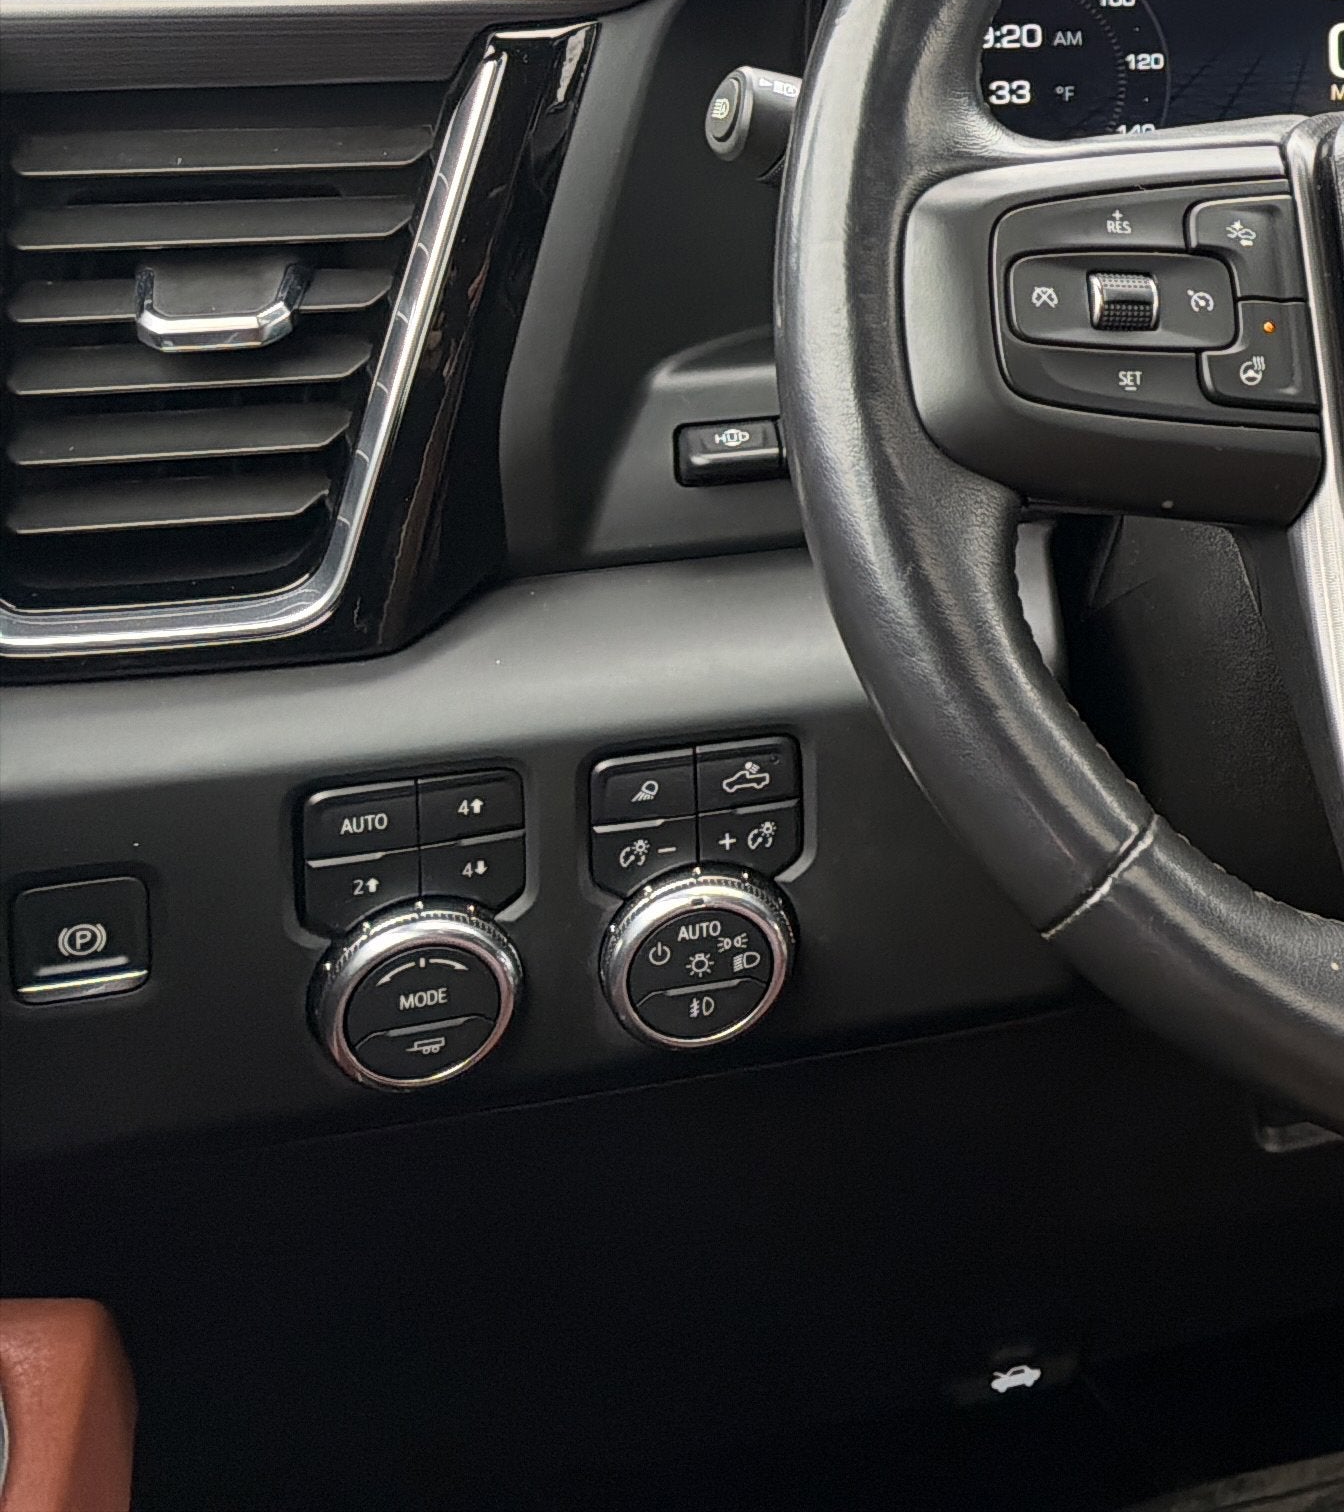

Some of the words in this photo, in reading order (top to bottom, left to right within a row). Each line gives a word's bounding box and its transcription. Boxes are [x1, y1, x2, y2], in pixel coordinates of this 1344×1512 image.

[1053, 31, 1083, 46] AM
[1125, 53, 1165, 70] 120
[988, 80, 1031, 105] 33
[1106, 220, 1133, 235] RES
[1118, 371, 1142, 387] SET
[714, 430, 750, 445] HUD
[457, 800, 471, 818] 4
[340, 814, 388, 835] AUTO
[461, 861, 475, 878] 4
[353, 878, 365, 896] 2
[677, 921, 722, 942] AUTO
[399, 987, 448, 1010] MODE
